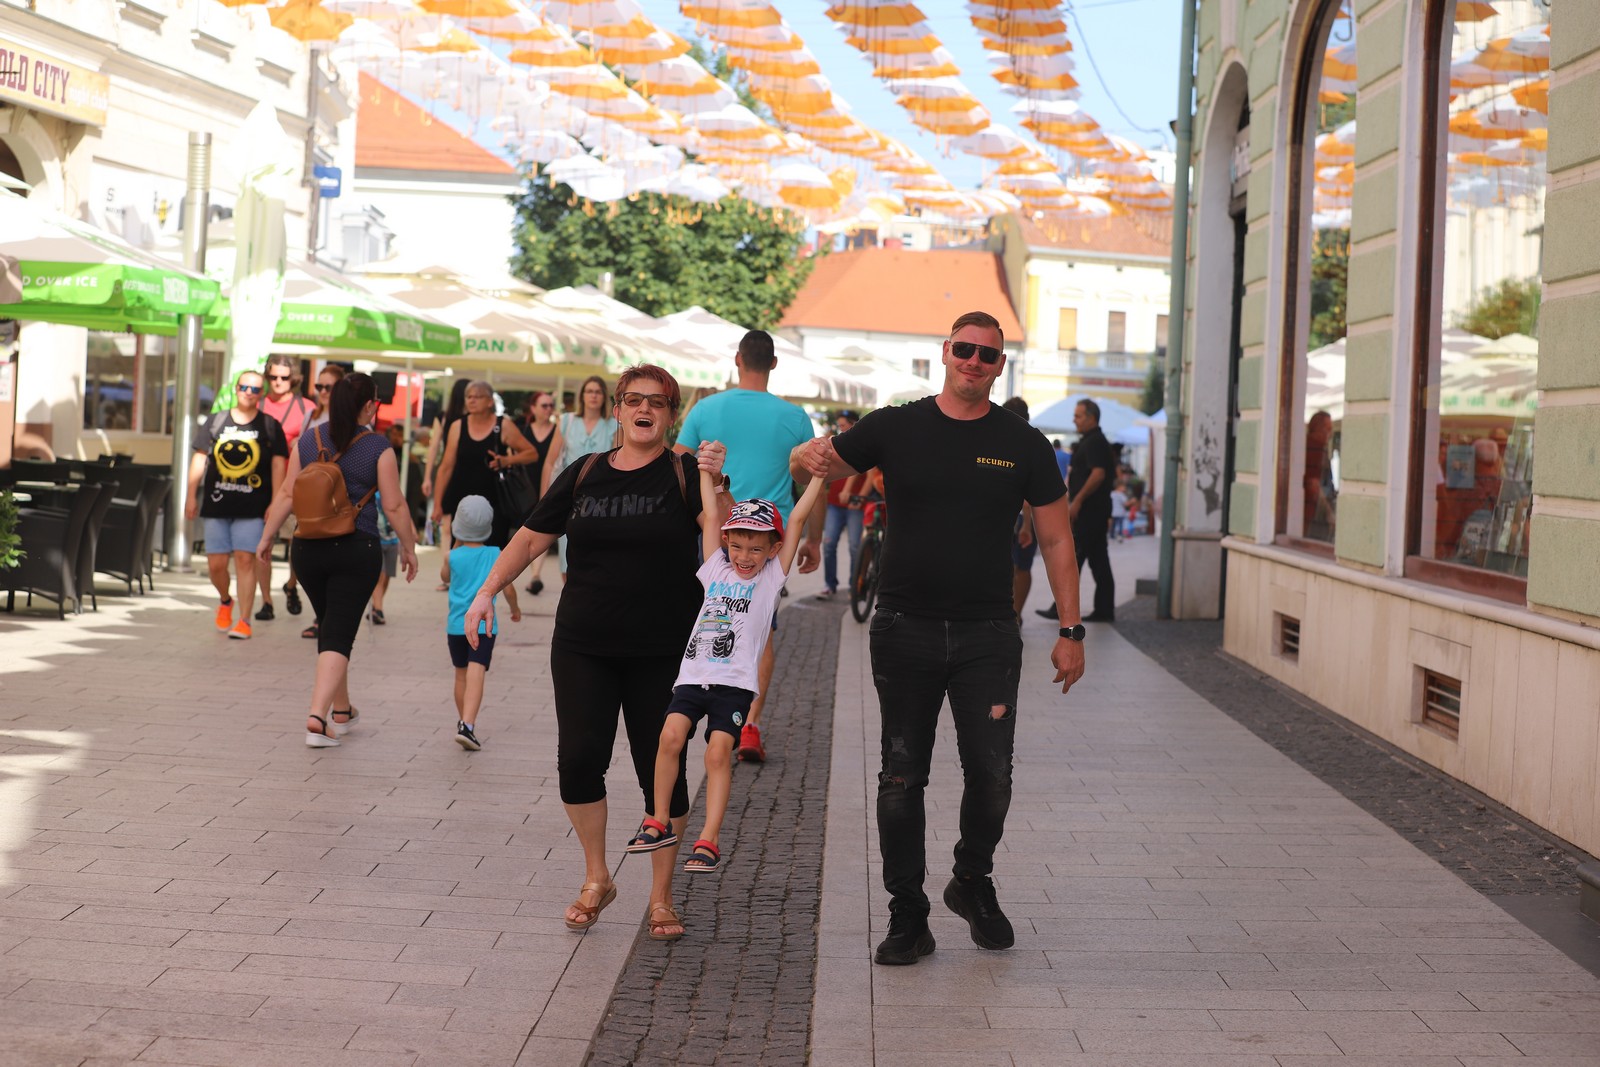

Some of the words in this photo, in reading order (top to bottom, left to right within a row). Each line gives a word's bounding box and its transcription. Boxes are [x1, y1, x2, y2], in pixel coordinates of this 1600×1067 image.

[33, 60, 70, 104] CITY
[36, 276, 71, 287] OVER
[76, 276, 98, 287] ICE
[287, 312, 315, 322] OVER
[317, 314, 334, 323] ICE
[465, 339, 504, 353] PAN
[976, 457, 1015, 469] SECURITY
[721, 596, 751, 614] TRUCK
